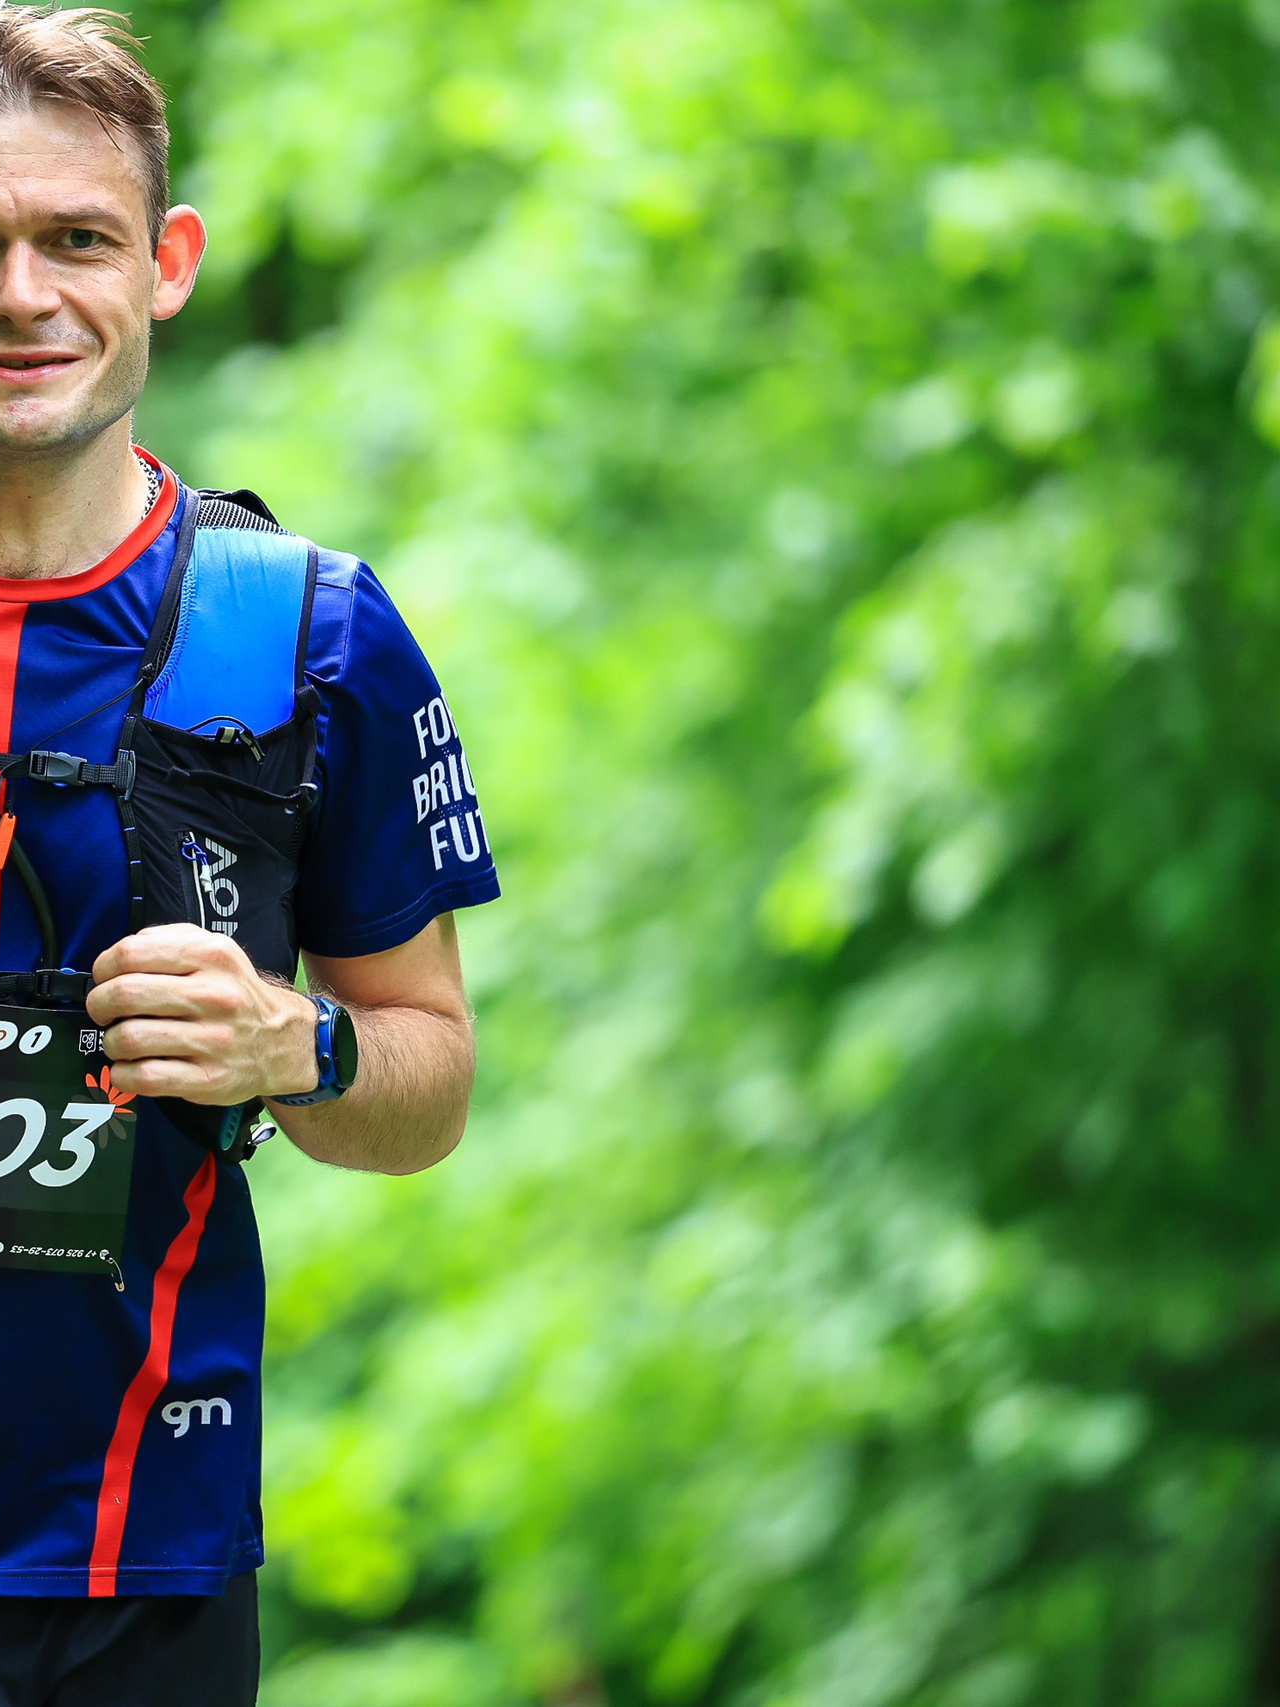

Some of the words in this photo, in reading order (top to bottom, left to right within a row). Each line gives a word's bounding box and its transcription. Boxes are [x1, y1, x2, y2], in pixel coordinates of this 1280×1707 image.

[30, 1031, 43, 1048] 1
[10, 1245, 65, 1257] 073-29-53
[66, 1248, 84, 1257] 925
[161, 1397, 232, 1438] gm
